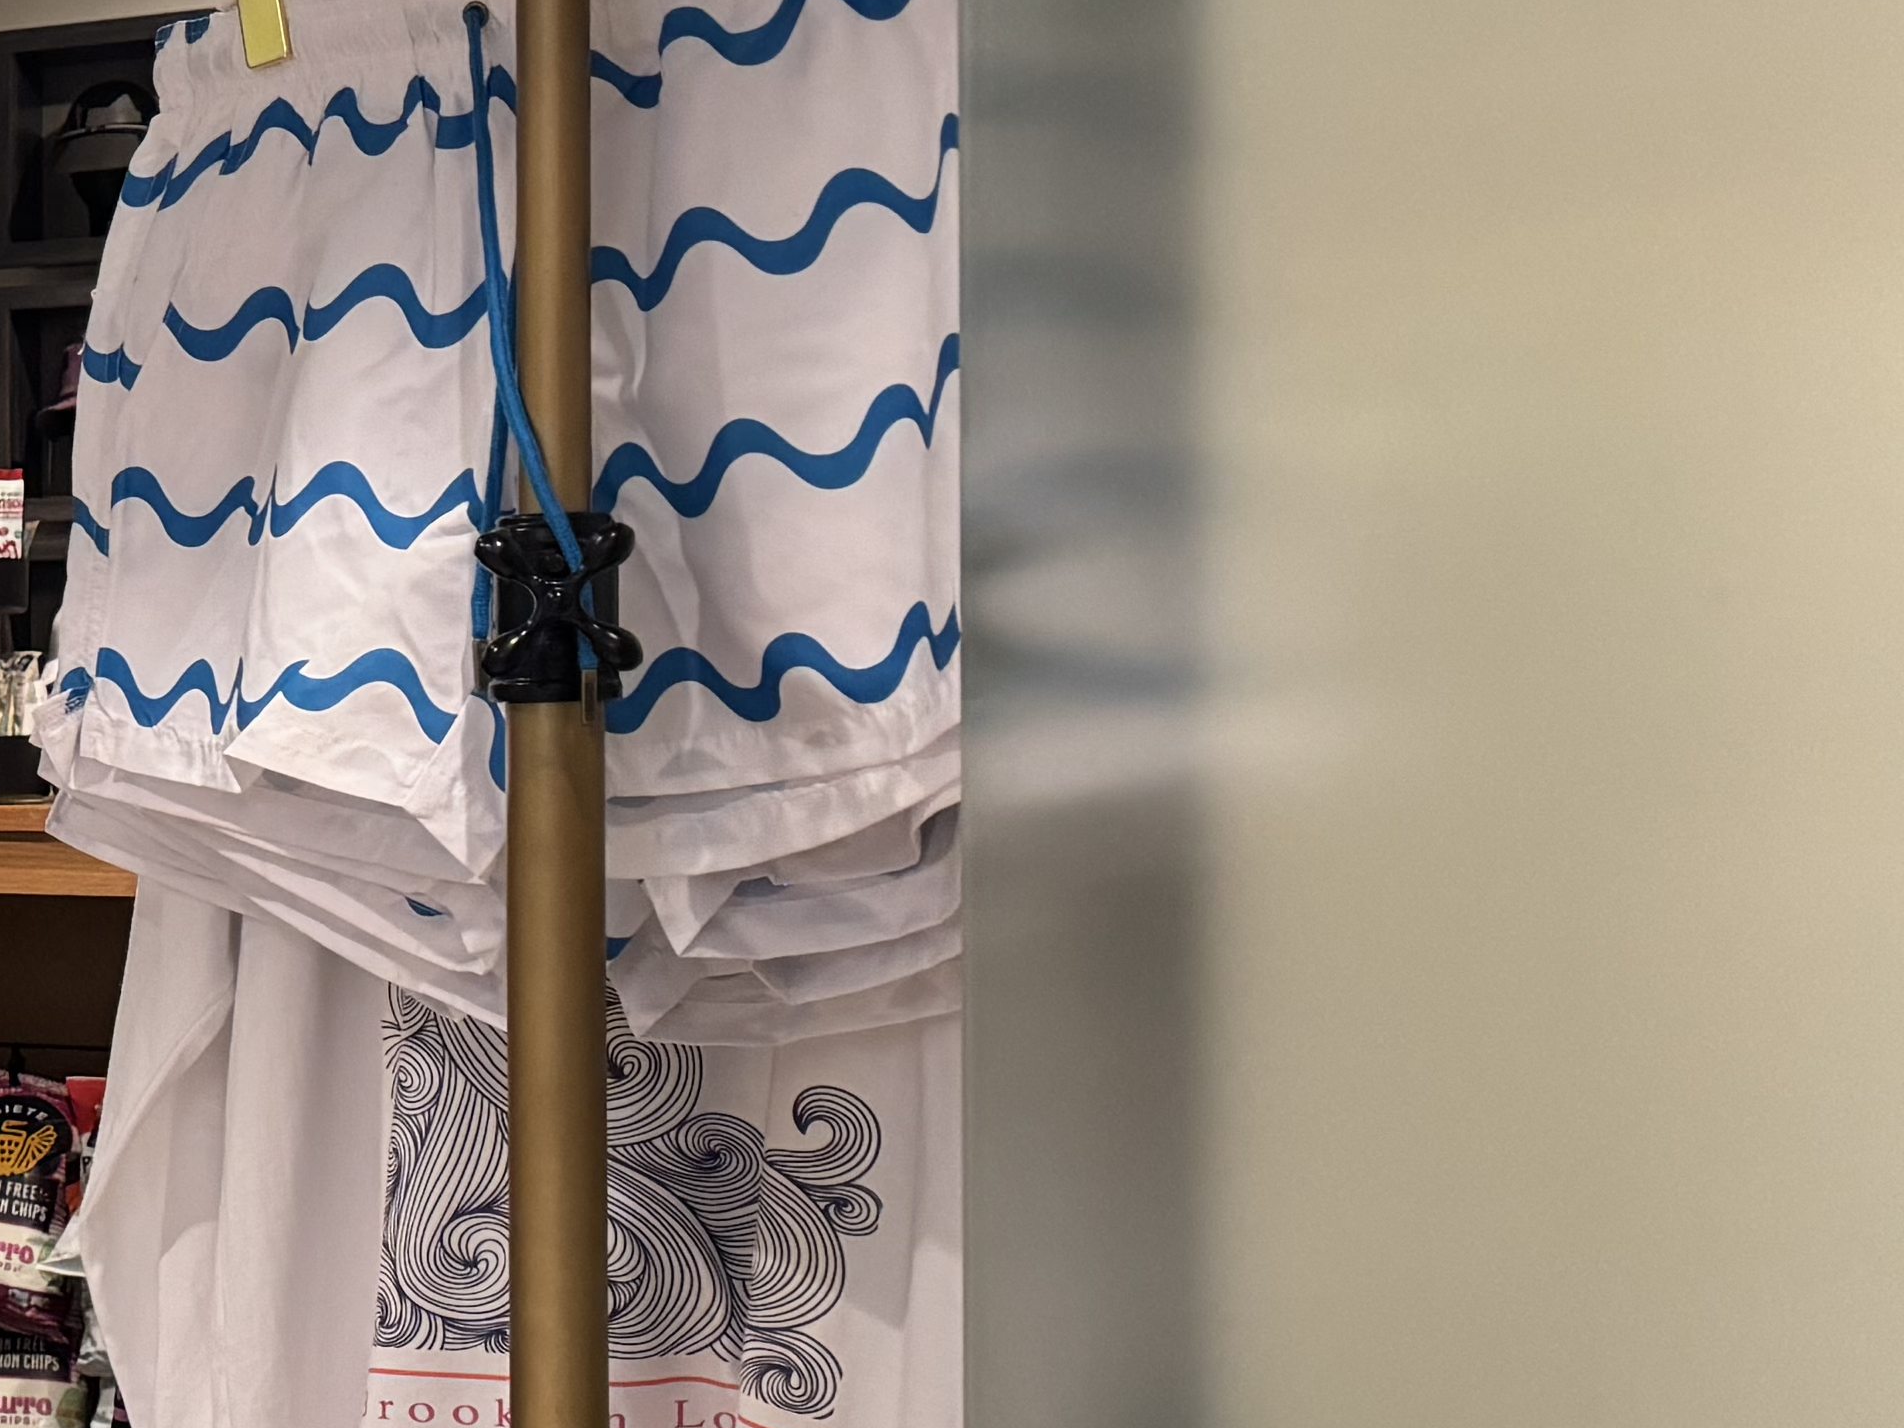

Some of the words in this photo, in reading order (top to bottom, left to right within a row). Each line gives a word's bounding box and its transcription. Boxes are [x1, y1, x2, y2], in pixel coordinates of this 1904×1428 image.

[6, 1181, 37, 1199] FREE
[11, 1201, 47, 1222] CHIPS
[23, 1354, 60, 1372] CHIPS
